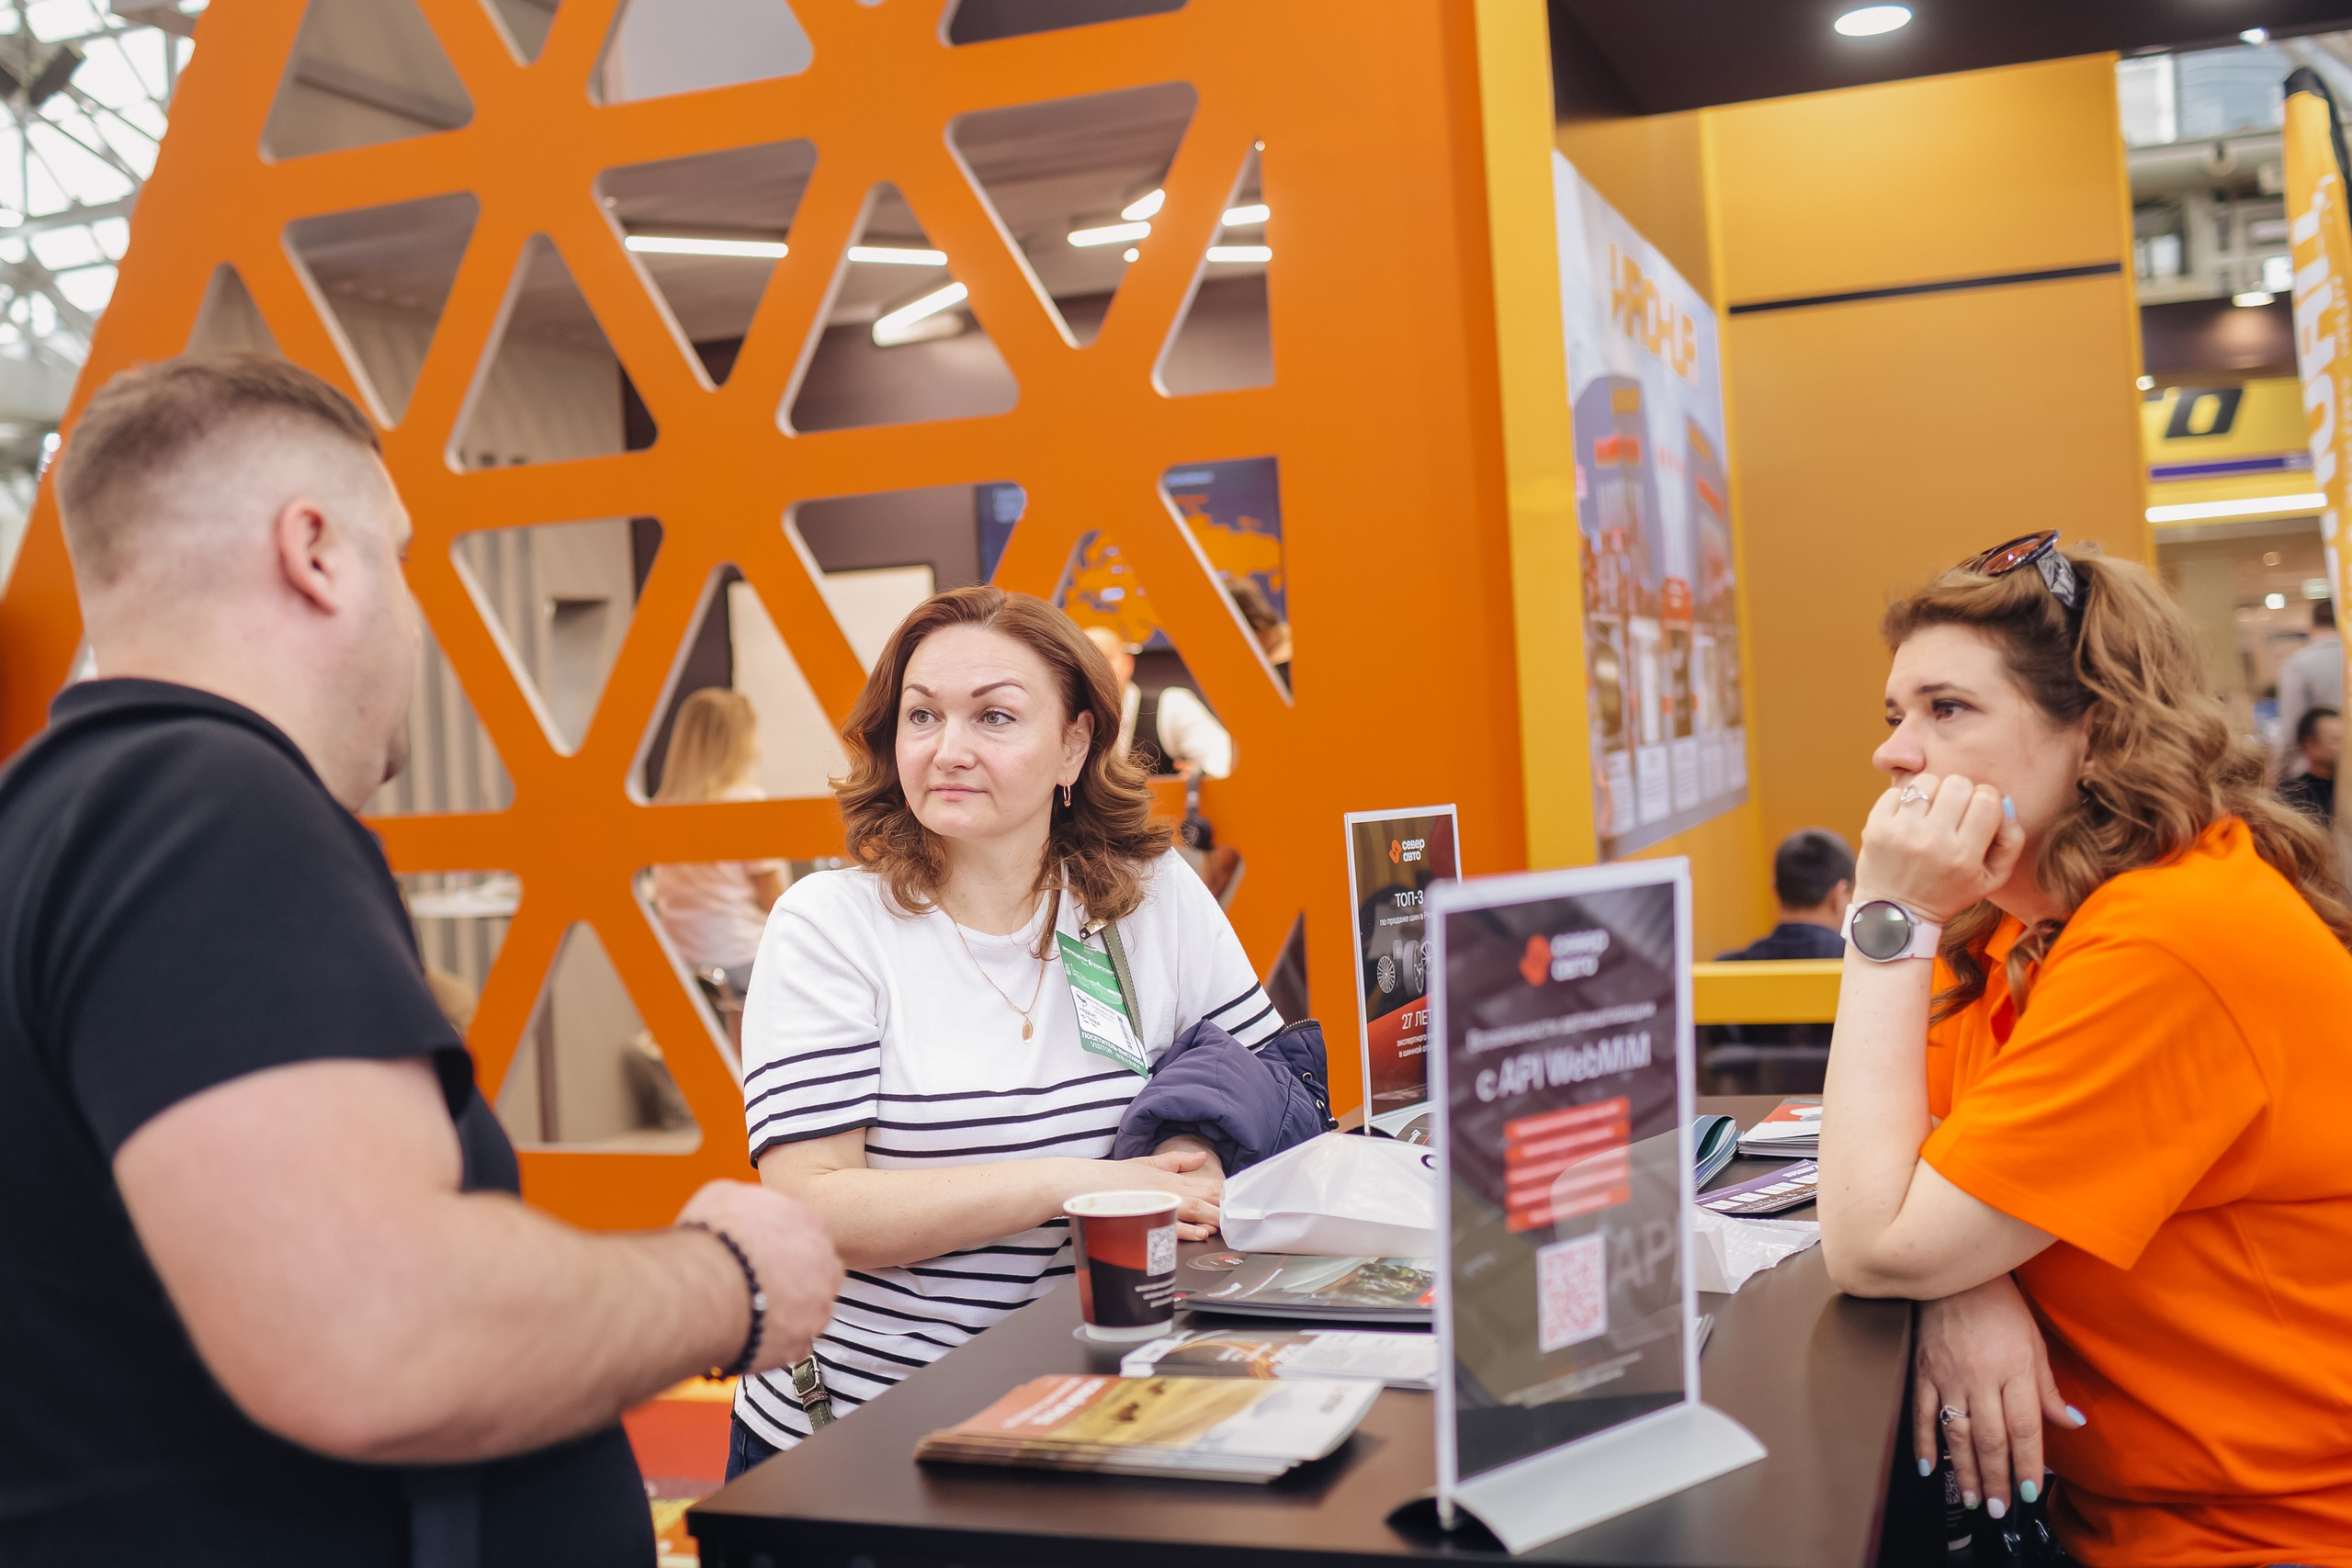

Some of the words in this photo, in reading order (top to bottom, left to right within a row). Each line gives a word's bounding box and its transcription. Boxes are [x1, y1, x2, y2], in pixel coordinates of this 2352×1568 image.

[1401, 839, 1425, 851] север
[1403, 851, 1421, 862] авто
[1395, 890, 1424, 908] ТОП-3
[1387, 916, 1408, 926] продаже
[1409, 914, 1419, 922] шин
[1401, 1012, 1413, 1030] 27
[1415, 1009, 1432, 1027] ЛЕТ
[1498, 1054, 1544, 1099] API
